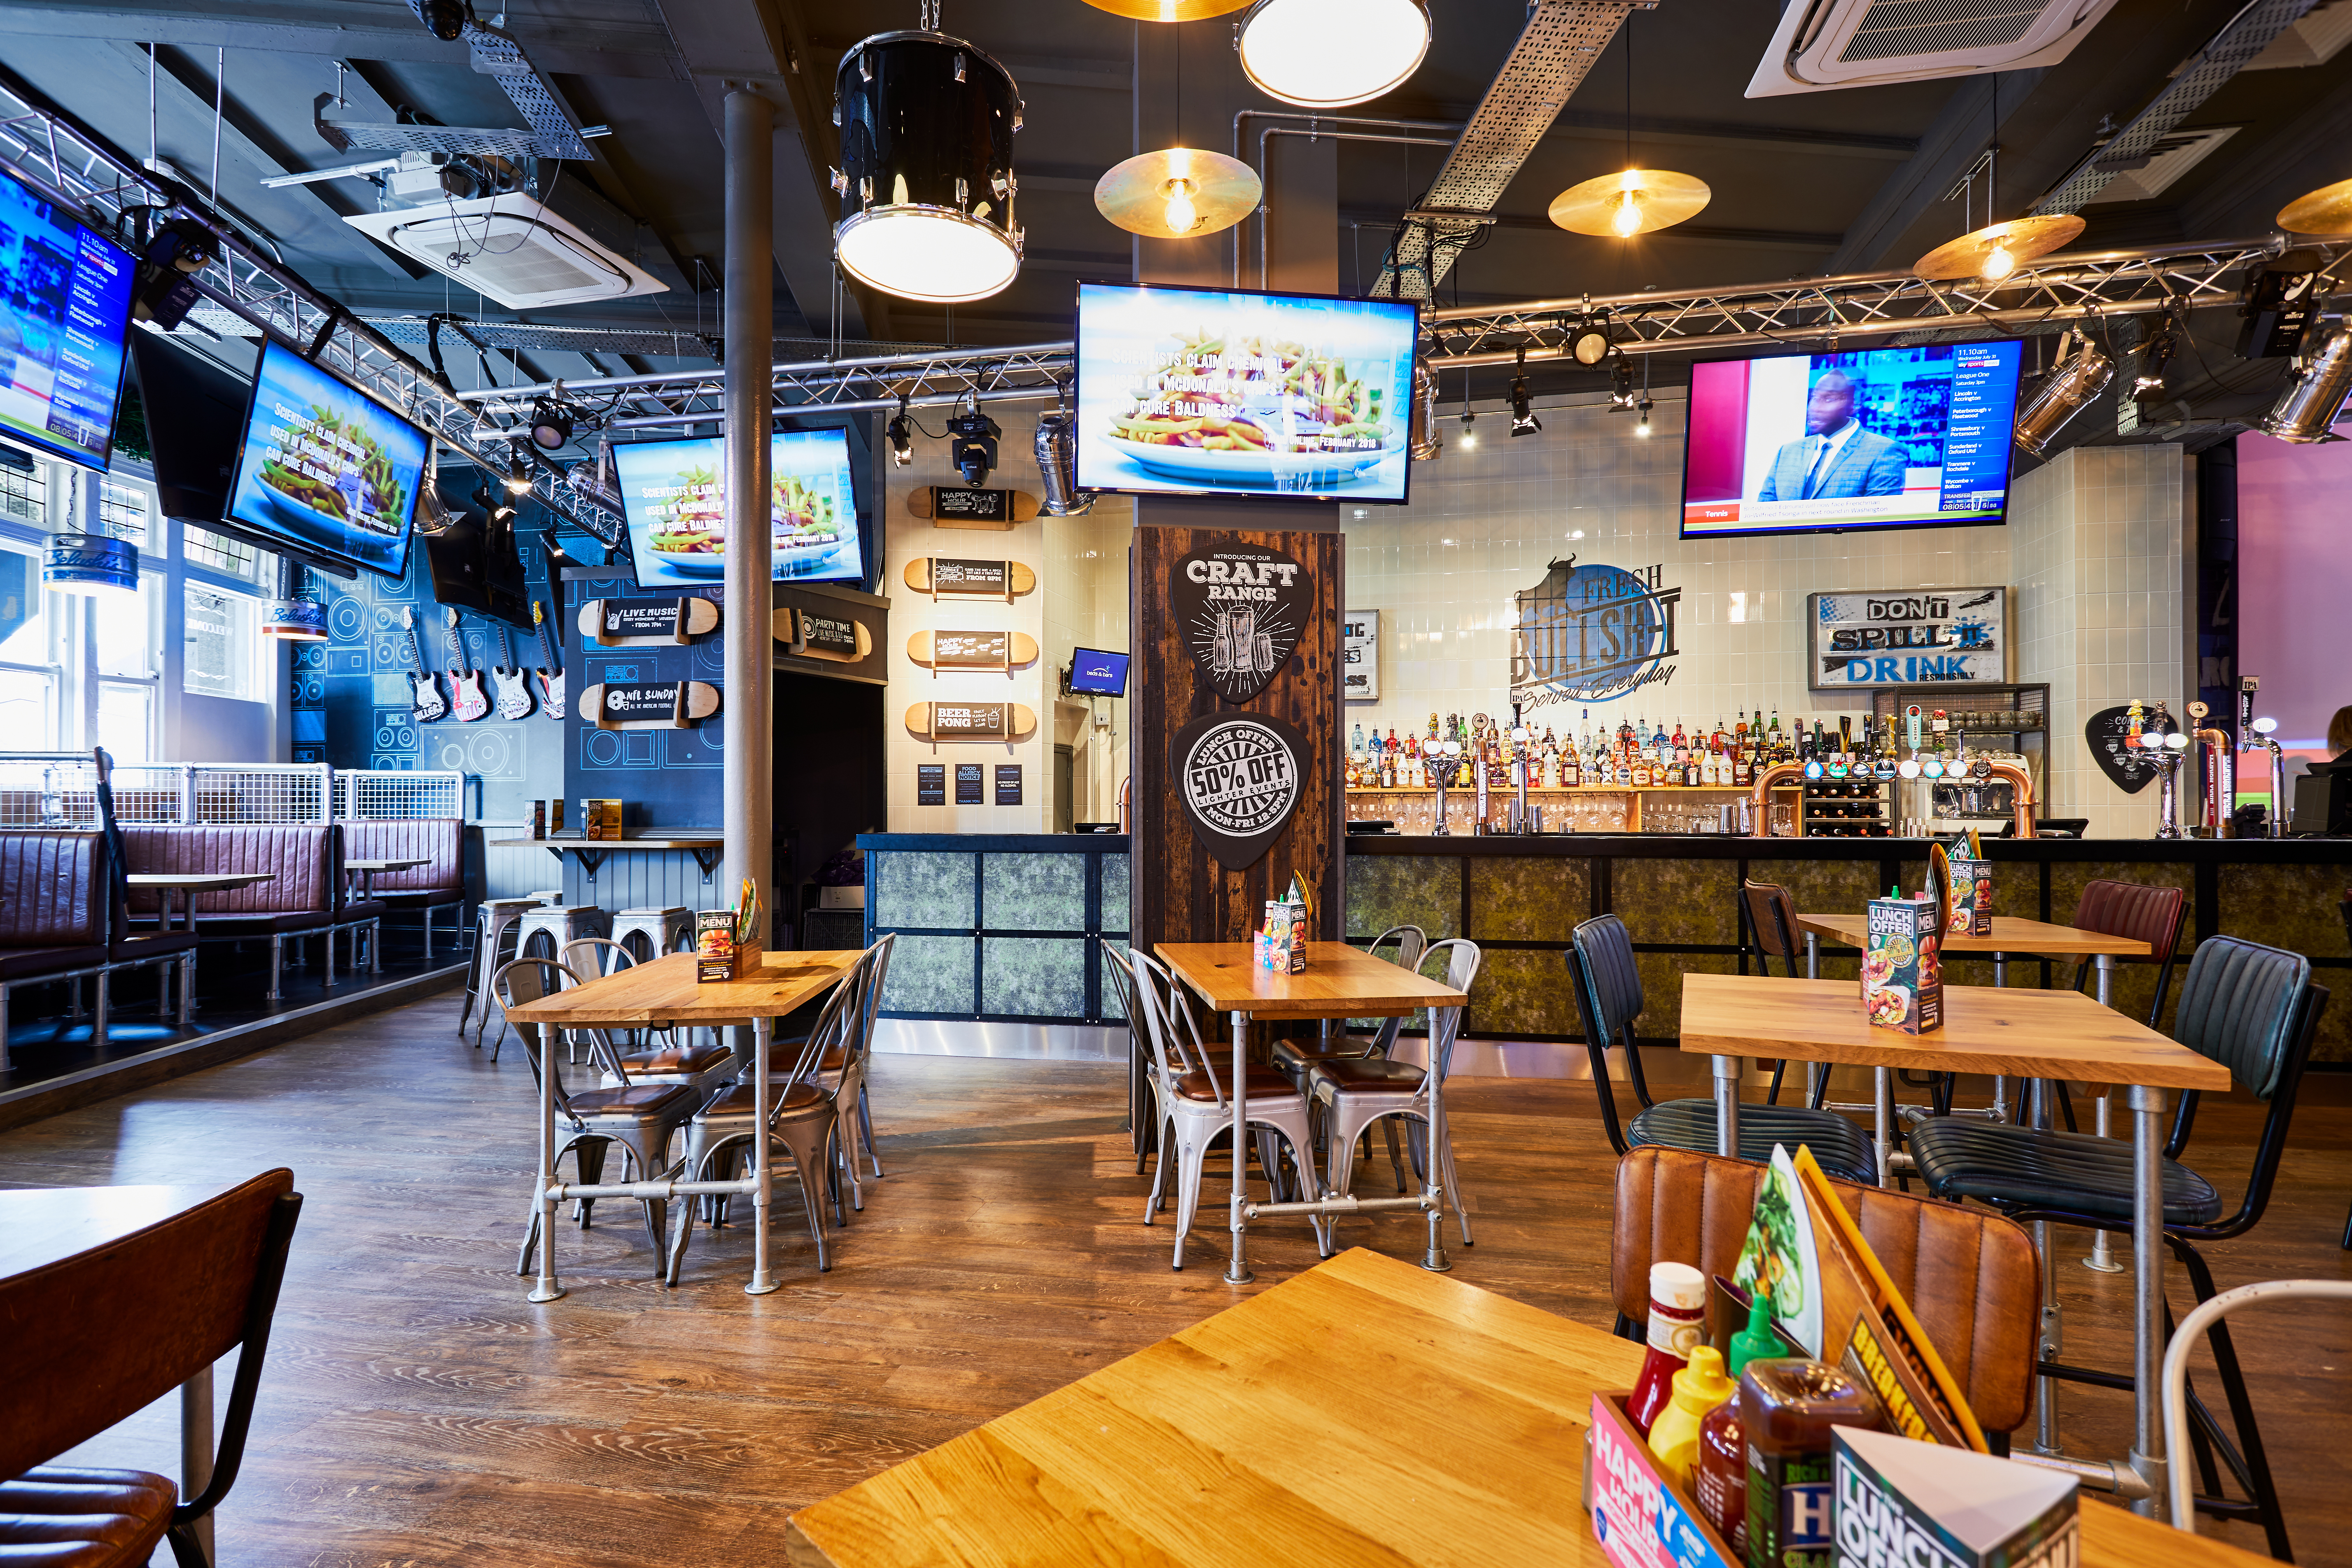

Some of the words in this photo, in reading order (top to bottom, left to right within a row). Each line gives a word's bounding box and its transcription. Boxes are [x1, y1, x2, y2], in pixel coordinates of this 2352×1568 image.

[82, 233, 108, 254] 11.10am
[1112, 348, 1182, 366] SCIENTISTS
[1186, 353, 1223, 369] CLAIM
[1227, 355, 1285, 372] CHEMICAL
[1113, 374, 1143, 389] USED
[1147, 376, 1159, 390] IN
[1244, 381, 1277, 396] CHIPS
[1112, 399, 1135, 413] CAN
[1139, 400, 1170, 415] CURE
[1175, 400, 1237, 418] BALDNESS
[275, 402, 315, 433] SCIENTISTS
[316, 425, 336, 445] CLAIM
[337, 436, 366, 461] CHEMICAL
[1319, 436, 1356, 448] FEBRUARY
[1358, 438, 1376, 448] 2018
[270, 424, 290, 443] USED
[290, 434, 300, 448] IN
[341, 460, 359, 477] CHIPS
[266, 446, 282, 462] CAN
[282, 453, 301, 471] CURE
[302, 461, 336, 487] BALDNESS
[642, 486, 688, 498] SCIENTISTS
[691, 484, 716, 495] CLAIM
[645, 505, 666, 516] USED
[668, 504, 677, 514] IN
[648, 523, 665, 533] CAN
[666, 521, 688, 532] CURE
[1187, 560, 1297, 586] CRAFT
[1584, 564, 1663, 604] FRESH
[1209, 586, 1276, 601] RANGE
[271, 608, 322, 623] Belushi's
[623, 609, 646, 617] LIVE
[647, 607, 677, 616] MUSIC
[1867, 596, 1949, 620] DON'T
[816, 618, 834, 630] PARTY
[835, 622, 850, 632] TIME
[1832, 624, 1953, 651] SPILL
[1962, 627, 1980, 641] IT
[1847, 655, 1972, 682] DRINK
[1920, 672, 1975, 682] RESPONSIBLY
[626, 690, 642, 701] NFL
[1522, 679, 1587, 714] Served
[1590, 664, 1677, 700] Everyday
[938, 708, 971, 718] BEER
[938, 718, 971, 727] PONG
[1197, 731, 1233, 765] LUNCH
[1236, 729, 1275, 752] OFFER
[1191, 763, 1245, 798] 50%
[1247, 753, 1285, 785] OFF
[1198, 790, 1244, 805] LIGHTER
[1250, 780, 1290, 794] EVENTS
[1206, 806, 1255, 828] MON-FRI
[1257, 791, 1288, 824] 12-5PM
[1950, 864, 1971, 872] LUNCH
[1975, 867, 1990, 875] MENU
[1274, 907, 1289, 915] LUNCH
[1274, 914, 1289, 923] OFFER
[1291, 910, 1305, 919] MENU
[1871, 908, 1911, 924] LUNCH
[700, 917, 730, 927] MENU
[1871, 919, 1911, 936] OFFER
[1255, 936, 1265, 945] HAPPY
[1900, 943, 1910, 952] OFF
[1596, 1421, 1678, 1543] HAPPY
[1610, 1476, 1660, 1557] HOUR
